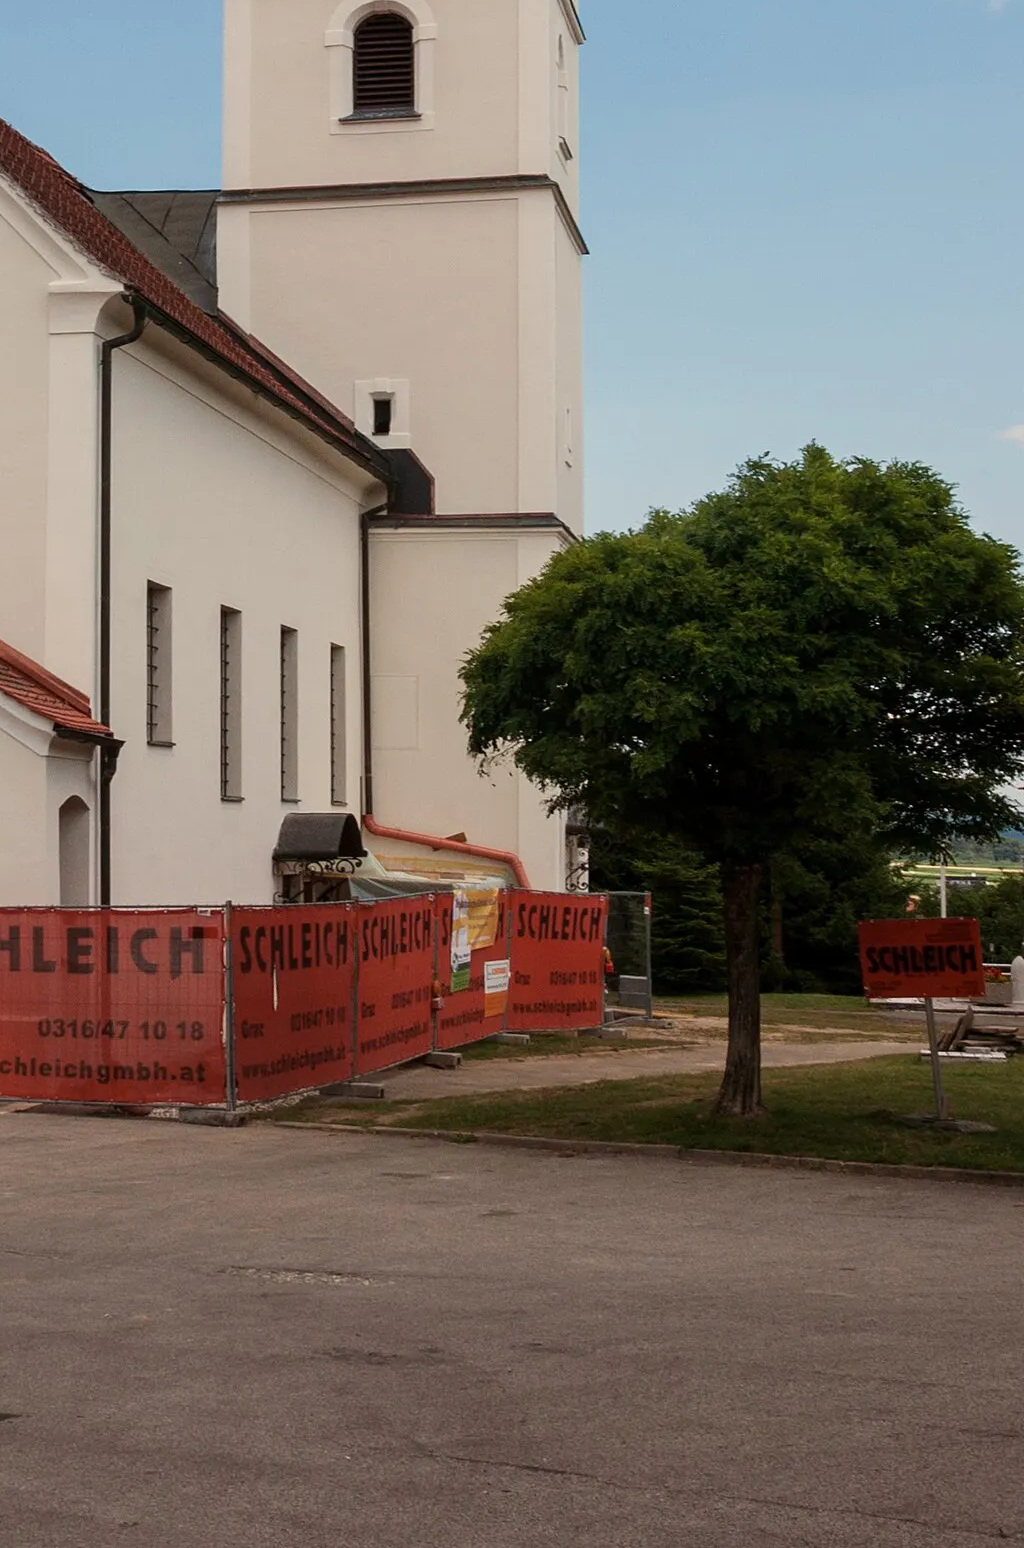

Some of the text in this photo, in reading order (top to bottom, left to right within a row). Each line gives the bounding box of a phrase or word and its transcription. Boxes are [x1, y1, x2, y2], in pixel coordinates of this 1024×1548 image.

[362, 908, 431, 963] SCHLEICH
[517, 903, 601, 943] SCHLEICH
[239, 920, 348, 977] SCHLEICH
[866, 945, 977, 974] SCHLEICH
[37, 1018, 129, 1040] 0316/47
[139, 1020, 167, 1040] 10
[176, 1021, 204, 1041] 18
